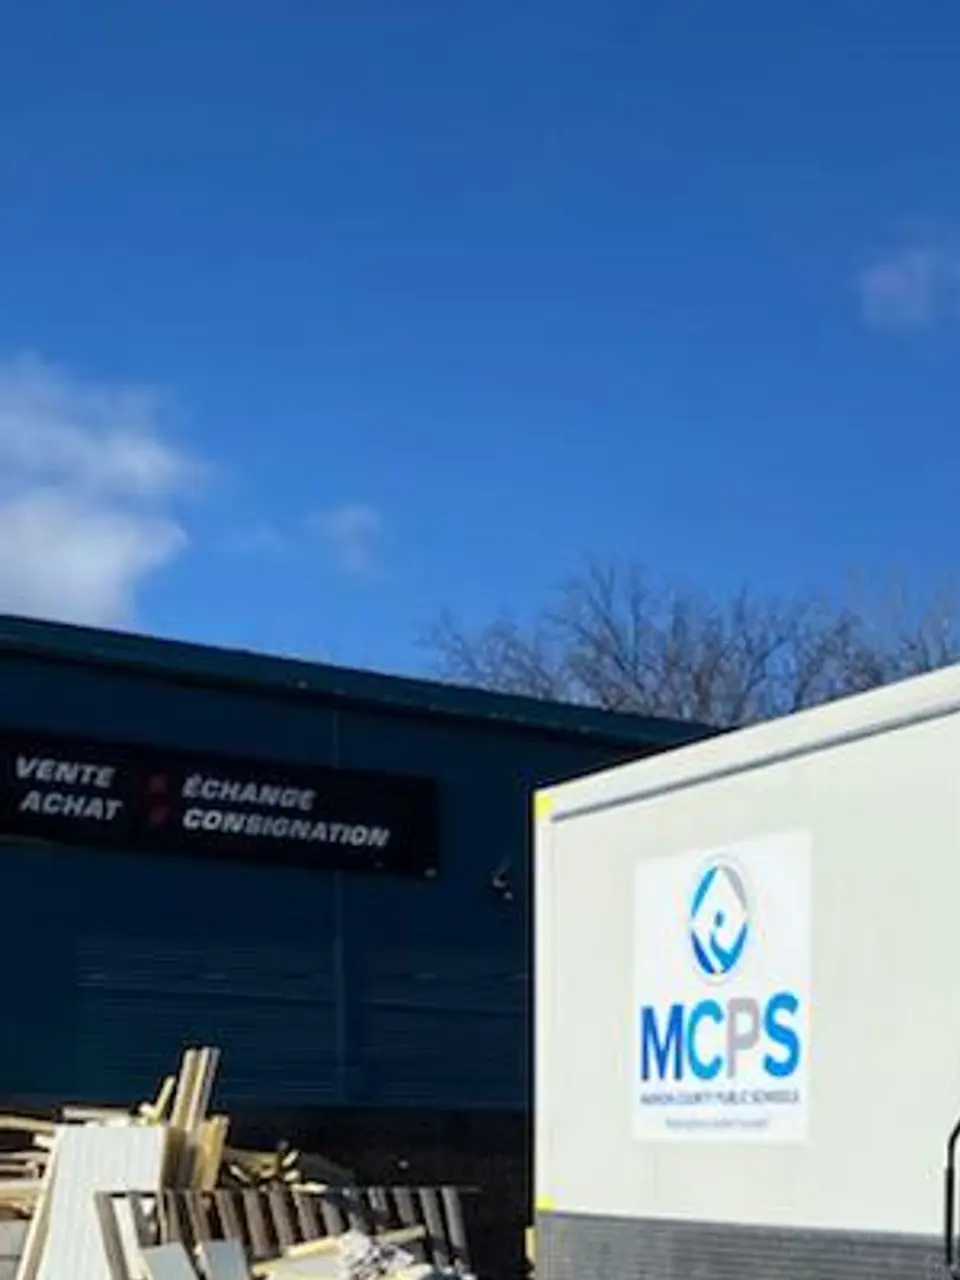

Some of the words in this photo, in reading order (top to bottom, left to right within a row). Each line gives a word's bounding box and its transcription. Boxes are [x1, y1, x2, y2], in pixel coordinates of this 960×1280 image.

[15, 756, 116, 788] VENTE
[20, 791, 123, 821] ACHAT
[183, 808, 390, 847] CONSIGNATION
[641, 991, 800, 1081] MCPS
